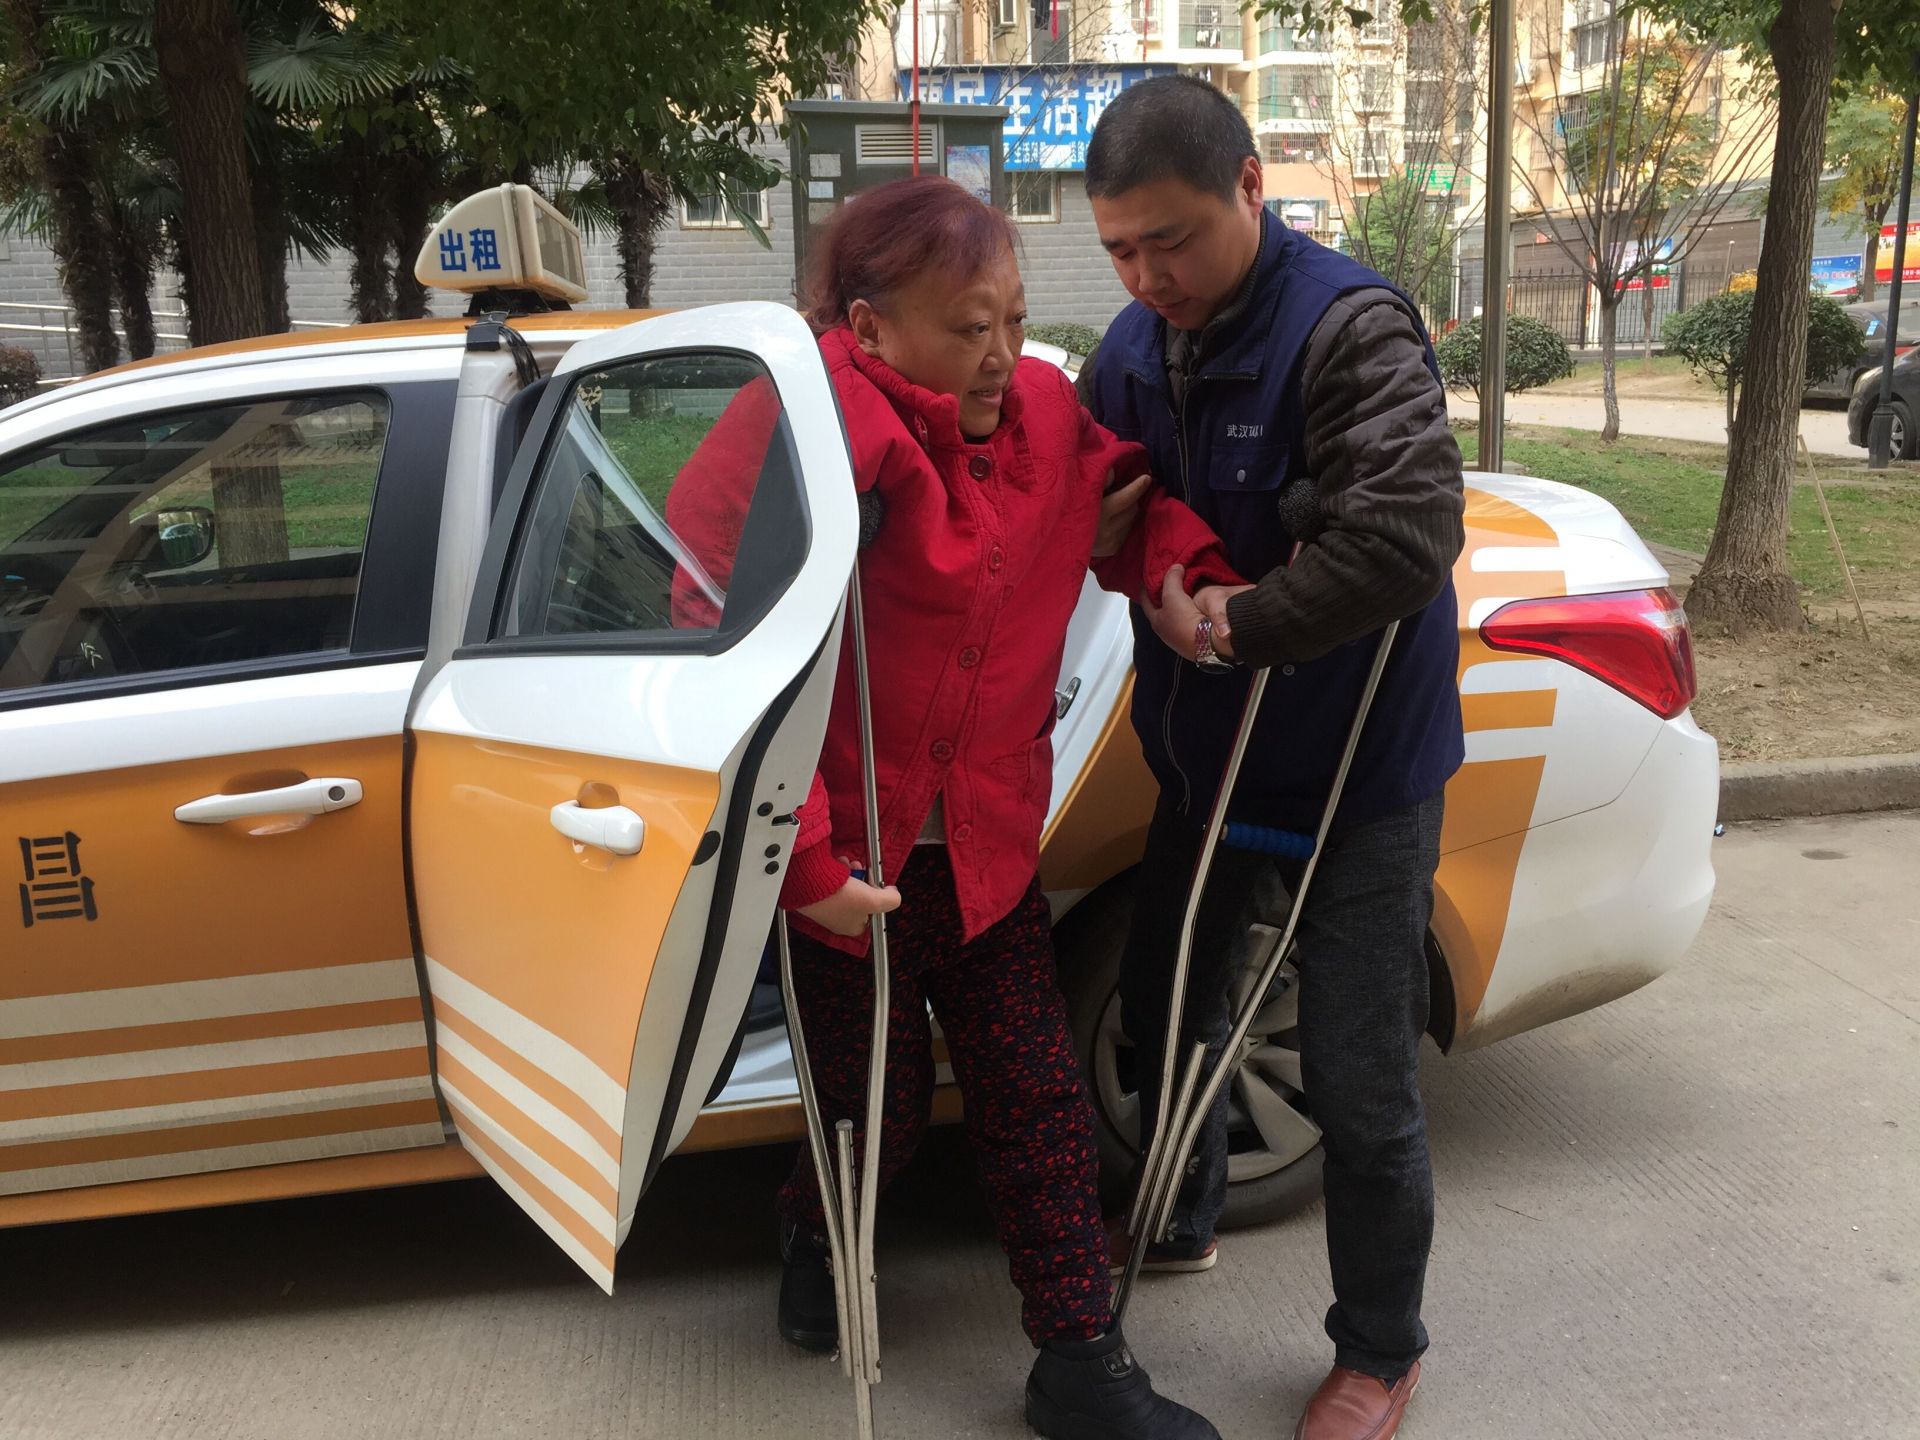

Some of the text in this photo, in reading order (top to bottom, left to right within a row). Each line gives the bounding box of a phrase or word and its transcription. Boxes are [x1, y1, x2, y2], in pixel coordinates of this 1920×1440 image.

[908, 71, 1154, 135] 民生活超
[439, 228, 501, 272] 出租
[1226, 424, 1263, 438] 武汉
[19, 831, 98, 928] 昌
